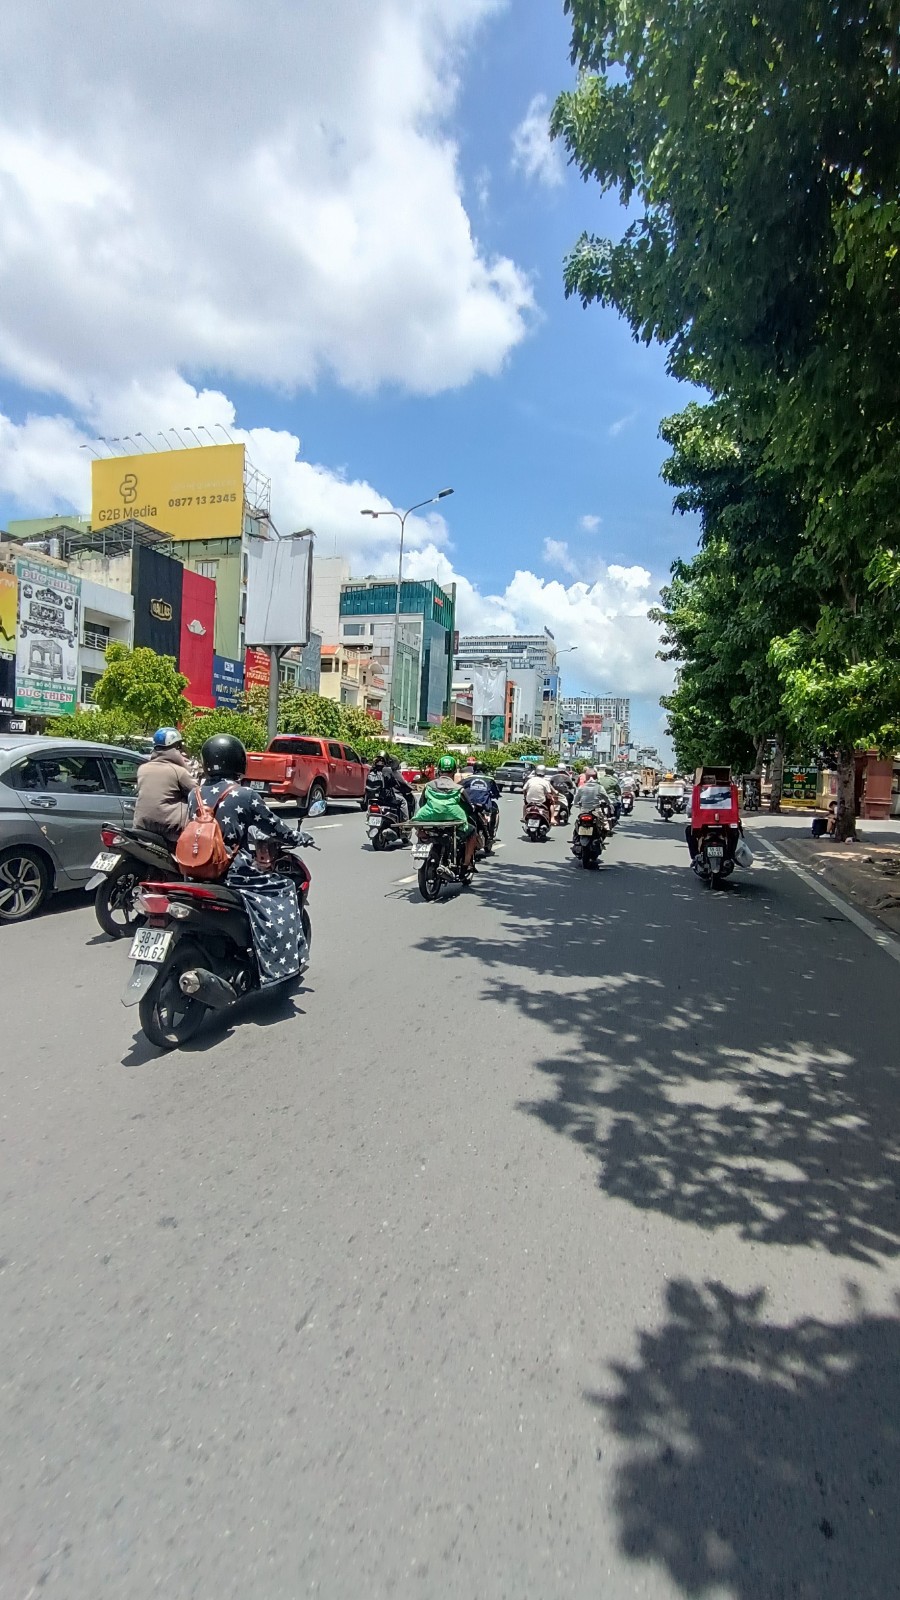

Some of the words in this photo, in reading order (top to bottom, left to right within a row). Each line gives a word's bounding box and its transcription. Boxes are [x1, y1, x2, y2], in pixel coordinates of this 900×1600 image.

[168, 496, 193, 507] 0877
[195, 496, 207, 505] 13
[209, 493, 237, 504] 2345
[98, 508, 121, 521] G2B
[123, 504, 157, 519] Media
[44, 690, 73, 702] THIỆN
[139, 931, 166, 946] 38-D1
[132, 945, 165, 961] 260.62
